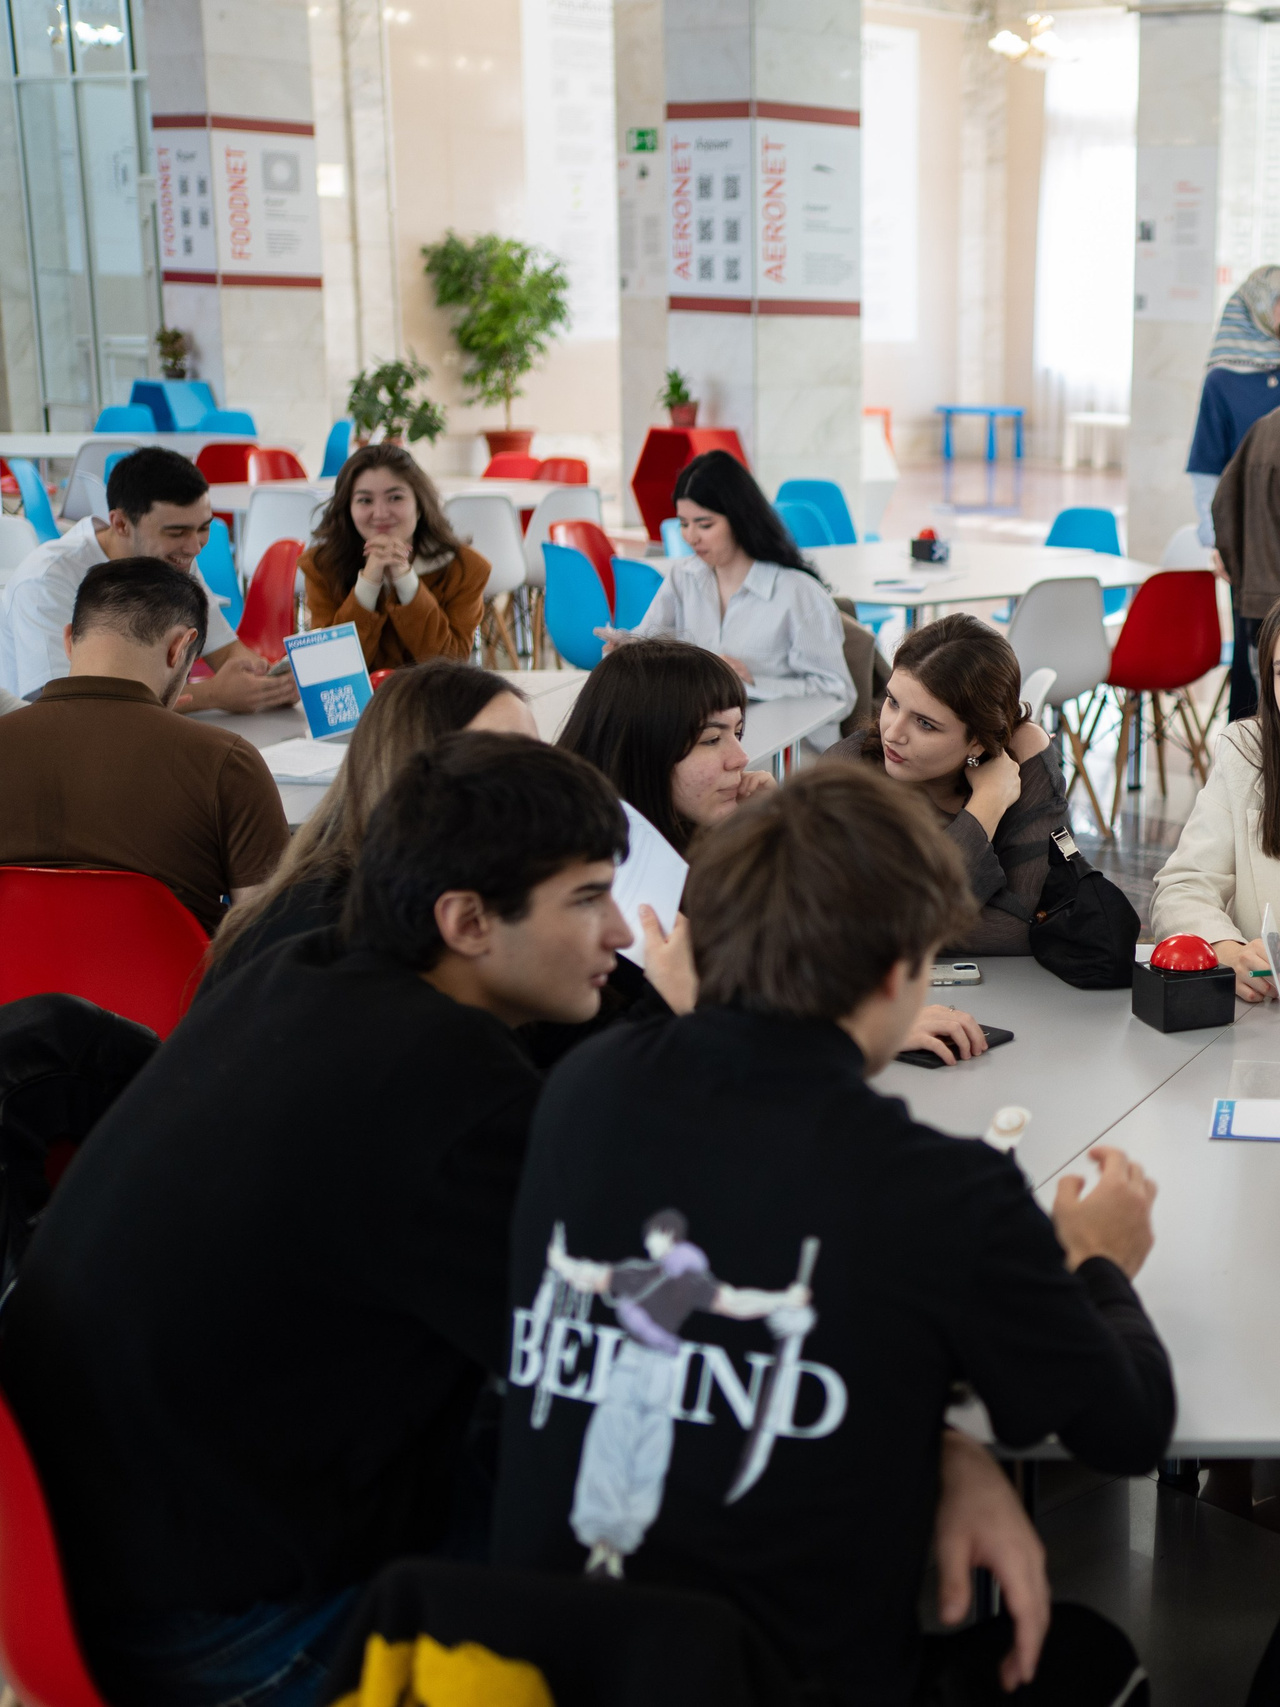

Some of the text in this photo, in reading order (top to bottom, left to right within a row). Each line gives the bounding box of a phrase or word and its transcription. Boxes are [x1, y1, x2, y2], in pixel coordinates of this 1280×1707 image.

[225, 146, 252, 260] FOODNET
[671, 134, 692, 281] AERONET
[761, 134, 787, 284] AERONET
[287, 632, 328, 650] КОМАНДА
